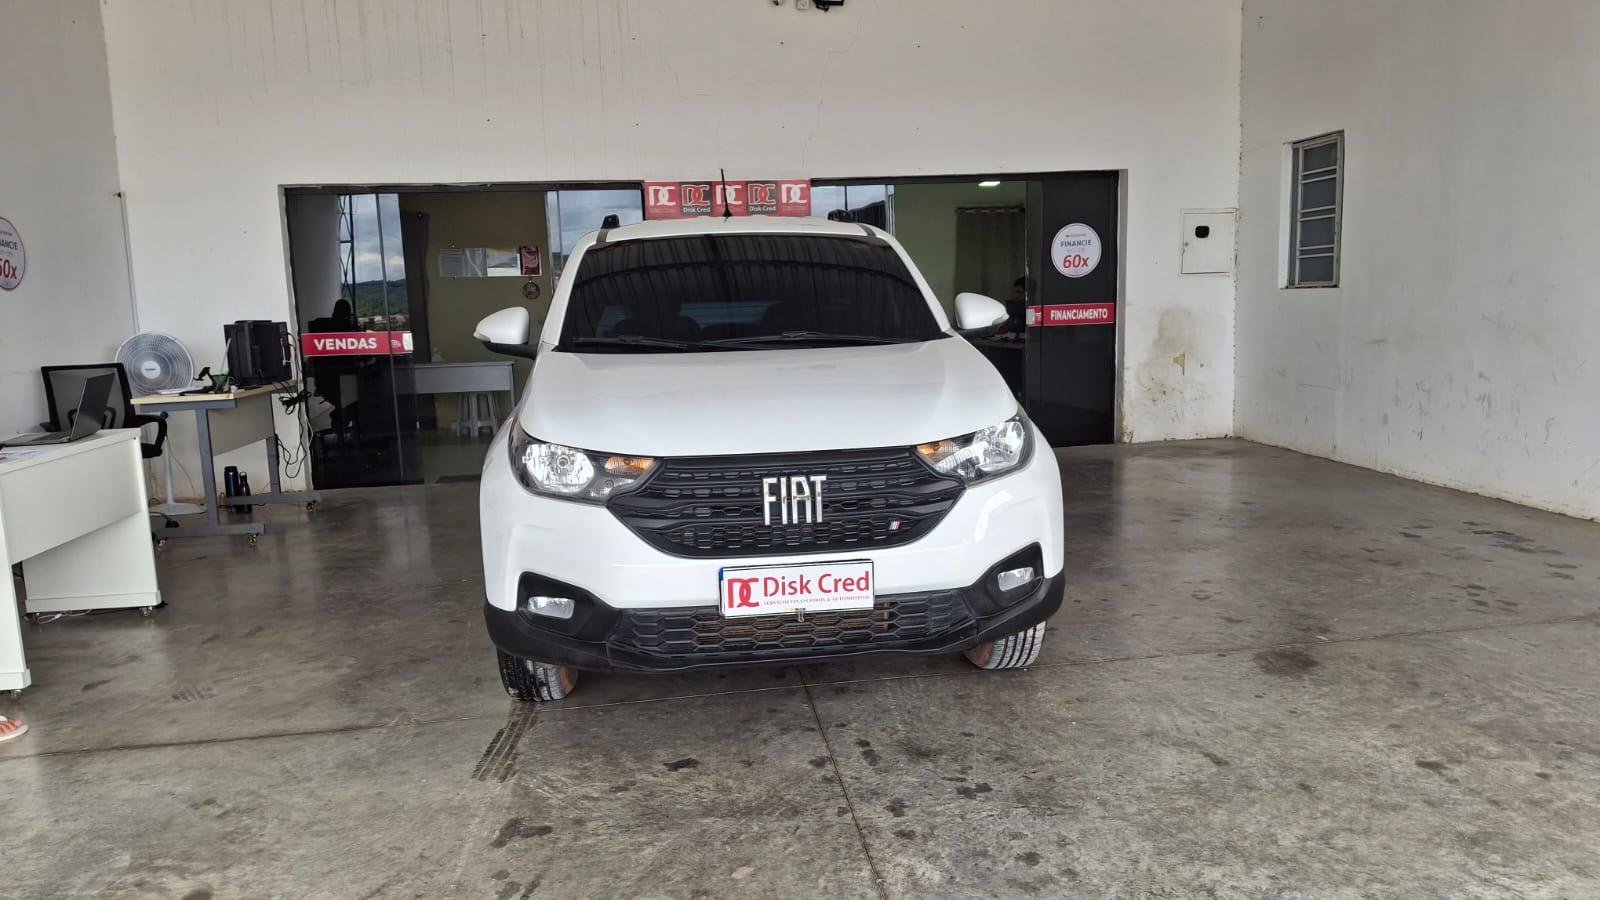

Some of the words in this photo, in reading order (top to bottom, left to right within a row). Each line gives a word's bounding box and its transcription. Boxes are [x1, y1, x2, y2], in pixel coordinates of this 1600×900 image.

[1060, 239, 1092, 248] FINANCIE
[1063, 254, 1090, 269] 60x
[1050, 308, 1108, 321] FINANCIAMENTO
[313, 337, 378, 351] VENDAS
[762, 475, 827, 526] FIAT
[763, 574, 812, 598] Disk
[817, 571, 870, 594] Cred
